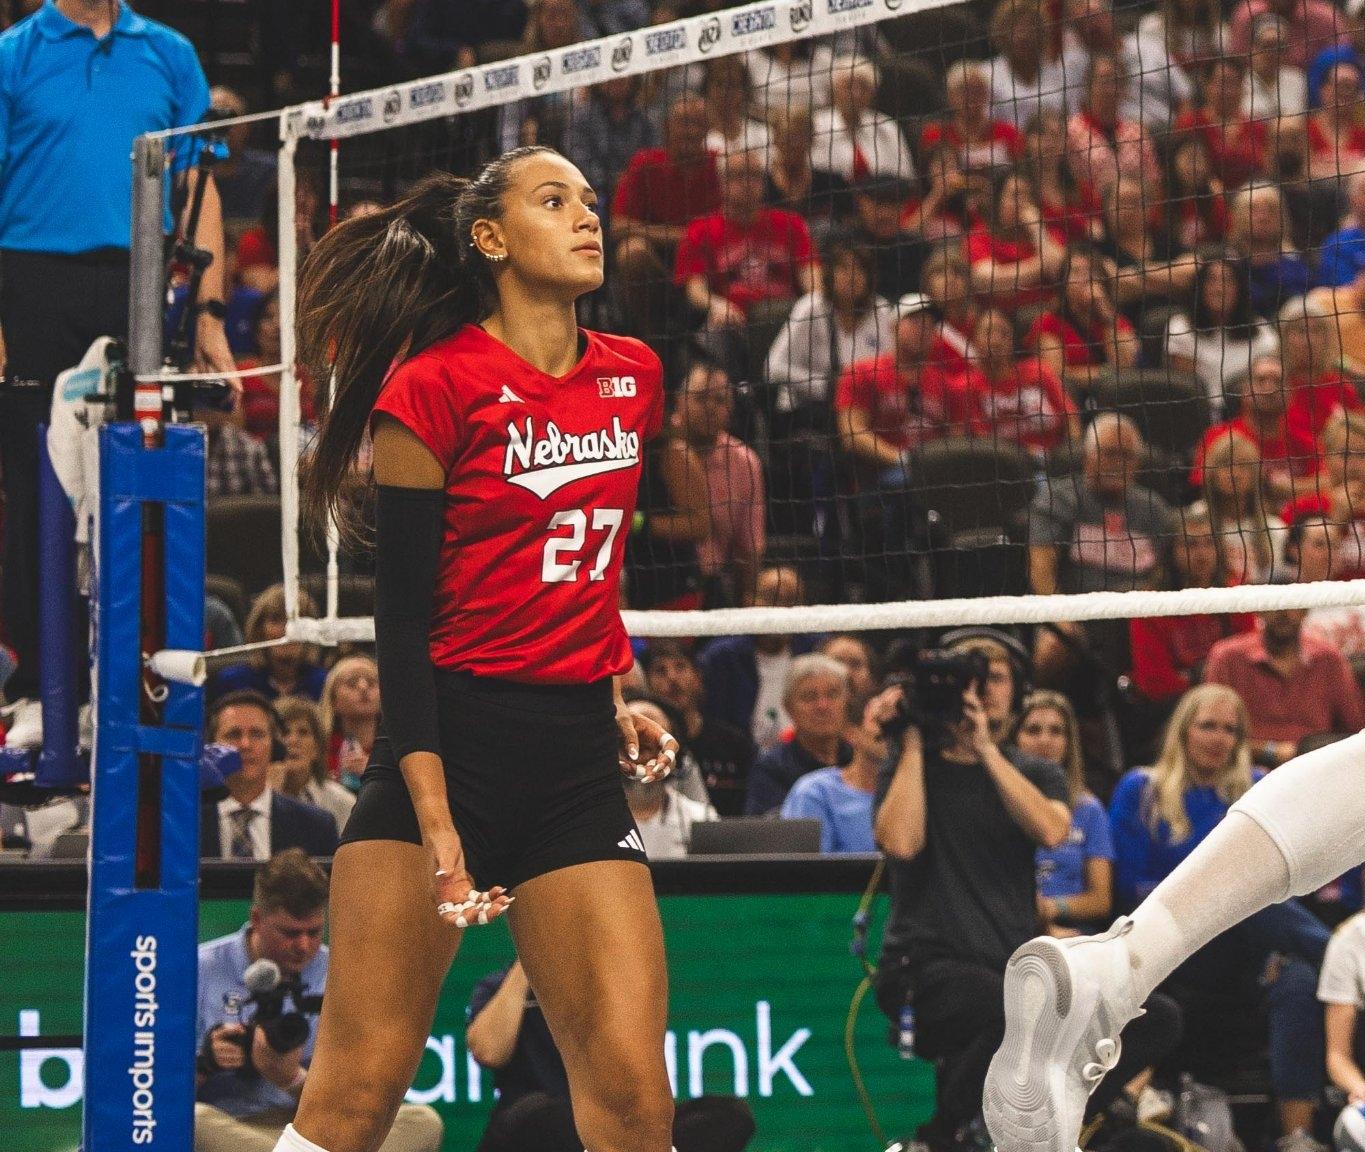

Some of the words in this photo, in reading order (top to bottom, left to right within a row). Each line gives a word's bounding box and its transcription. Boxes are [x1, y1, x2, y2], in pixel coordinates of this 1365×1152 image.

[503, 416, 640, 475] Nebraska
[541, 508, 624, 583] 27
[130, 935, 159, 1028] sports
[128, 1032, 157, 1145] imports
